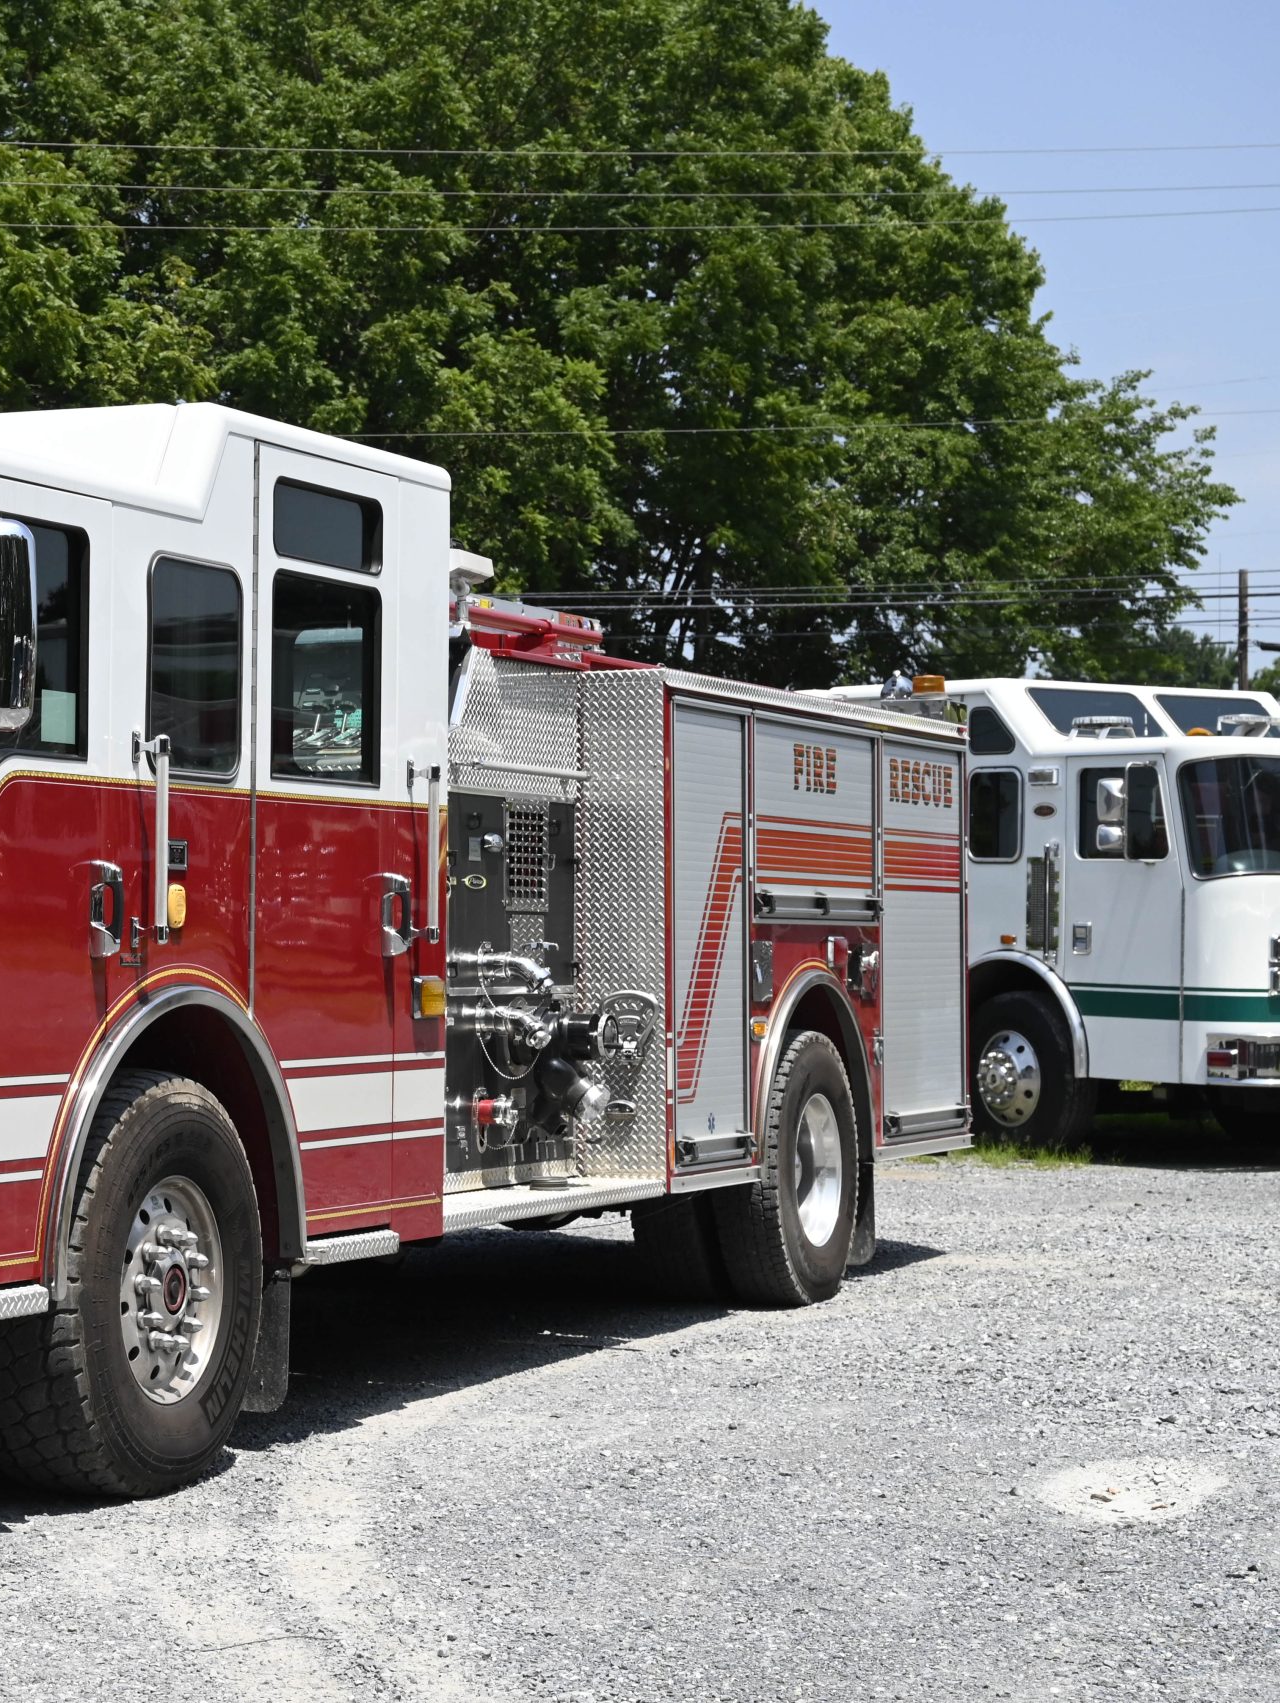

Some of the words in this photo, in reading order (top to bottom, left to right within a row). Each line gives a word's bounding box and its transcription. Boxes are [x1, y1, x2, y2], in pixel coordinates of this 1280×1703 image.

[793, 743, 837, 794] FIRE
[889, 758, 953, 809] RESCUE
[204, 1262, 252, 1426] MICHELIN
